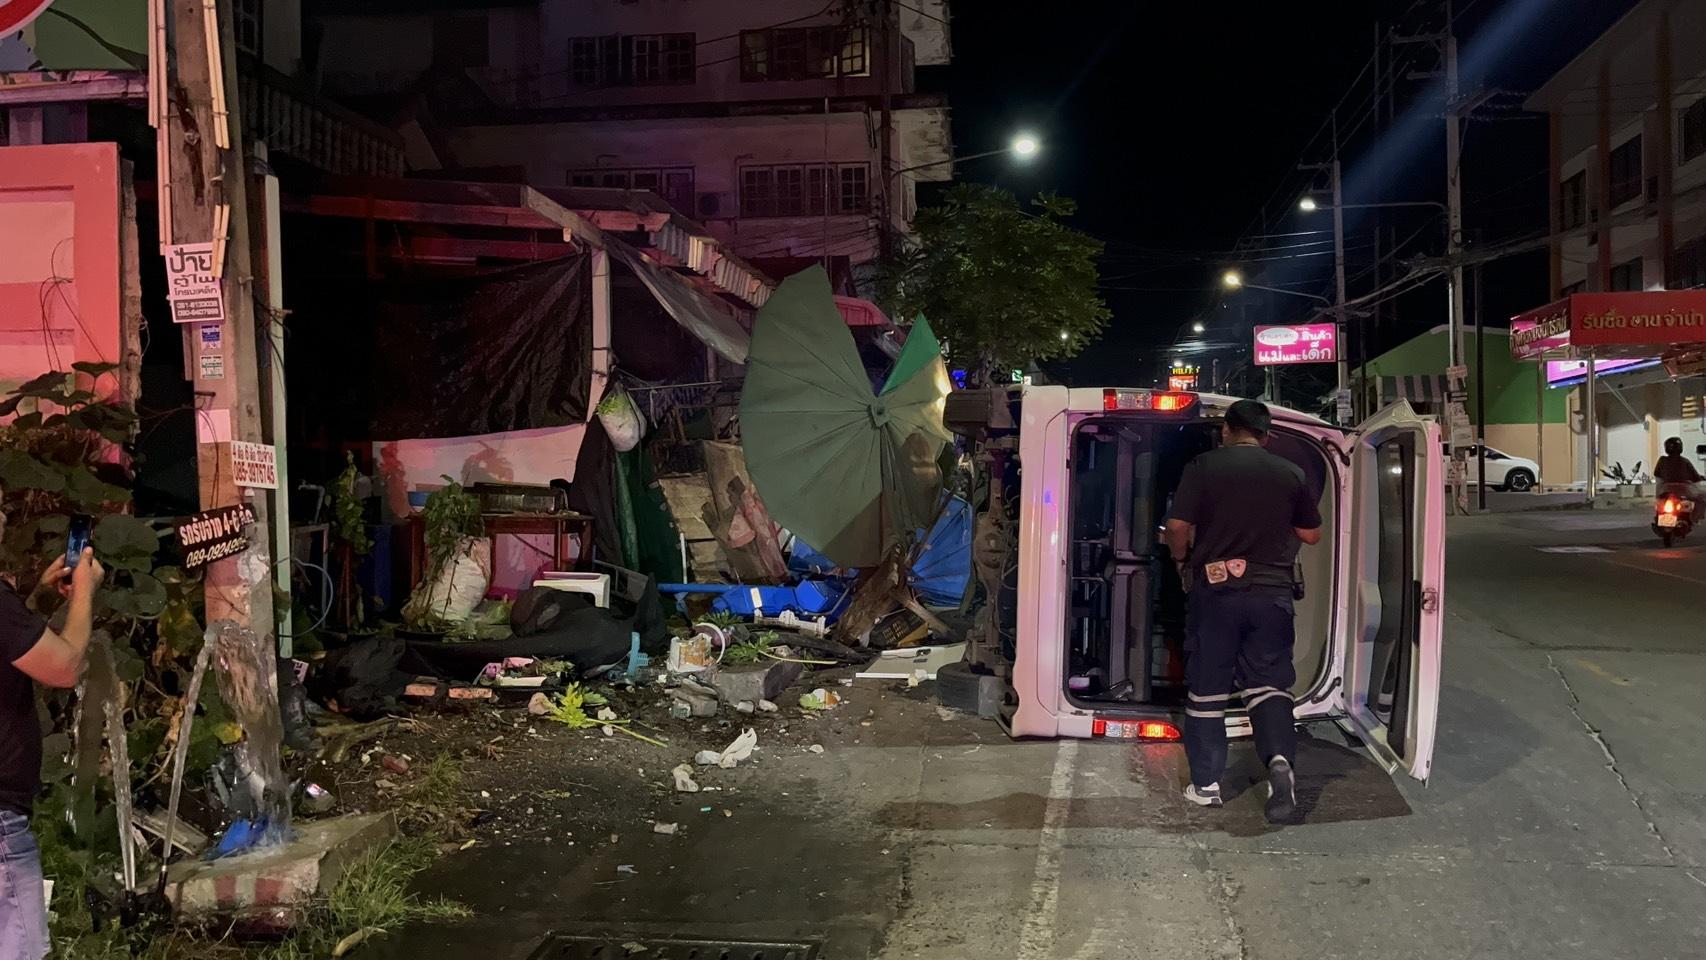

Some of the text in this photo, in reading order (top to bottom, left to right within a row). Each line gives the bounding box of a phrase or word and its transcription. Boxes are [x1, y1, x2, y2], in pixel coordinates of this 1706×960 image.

[1582, 307, 1626, 328] รับซื้อ
[1301, 329, 1332, 341] สินค้า
[1258, 341, 1331, 363] แม่และเด็ก
